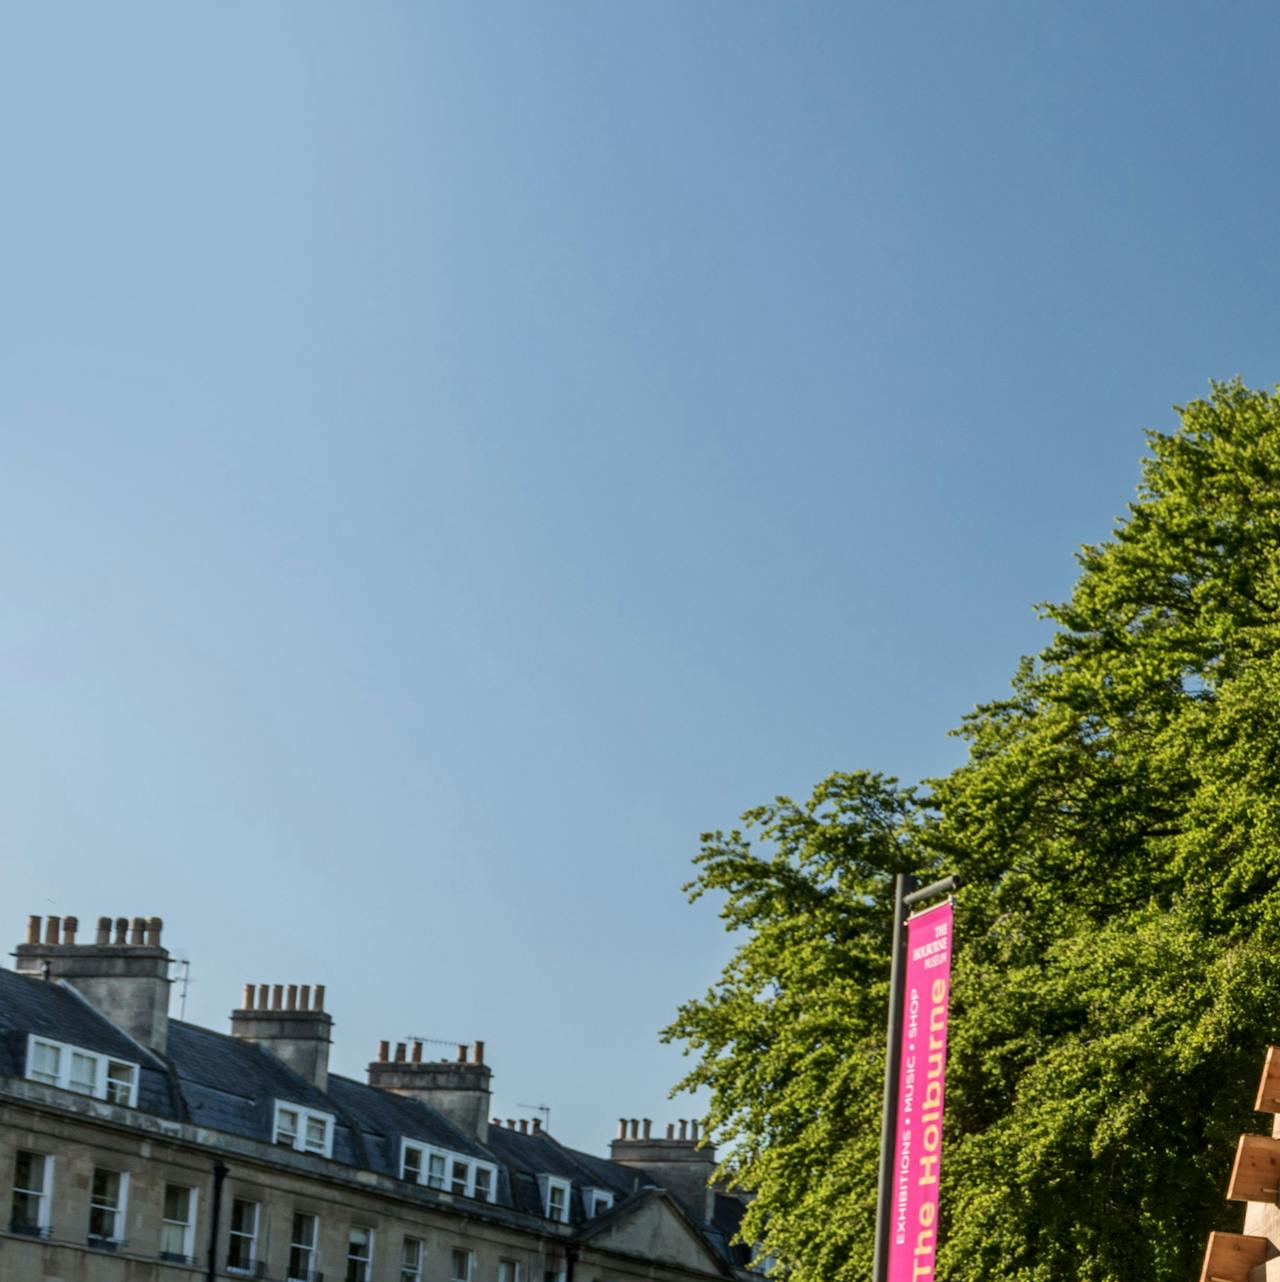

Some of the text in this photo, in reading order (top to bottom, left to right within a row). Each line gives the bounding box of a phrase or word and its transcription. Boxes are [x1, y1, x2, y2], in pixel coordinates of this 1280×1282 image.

[896, 988, 919, 1245] EXHIBITIONS MUSIC SHOP
[918, 978, 946, 1186] Holburne
